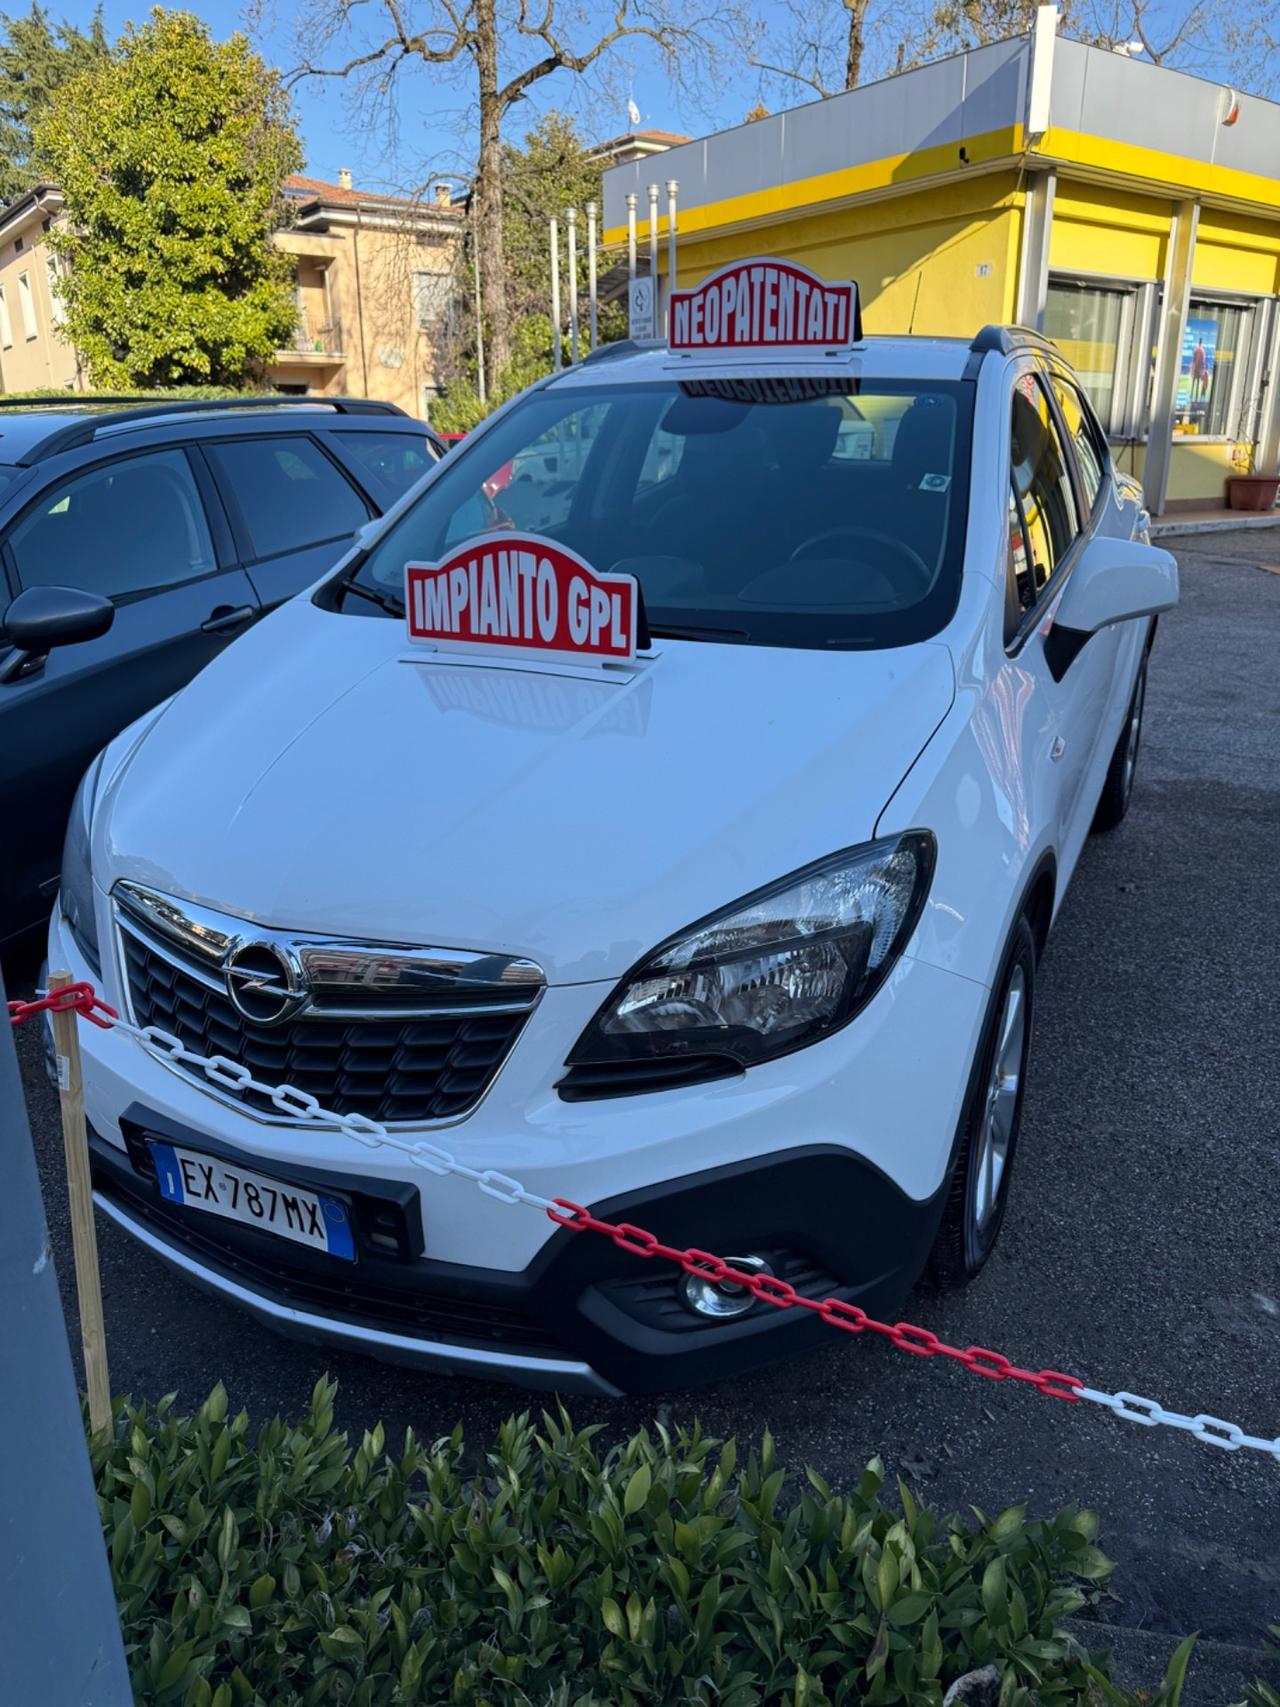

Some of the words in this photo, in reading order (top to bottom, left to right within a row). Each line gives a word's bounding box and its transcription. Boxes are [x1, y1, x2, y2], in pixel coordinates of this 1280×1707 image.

[675, 269, 846, 344] NEOPATENTATI
[414, 550, 558, 642] IMPIANTO
[568, 576, 626, 648] GPL
